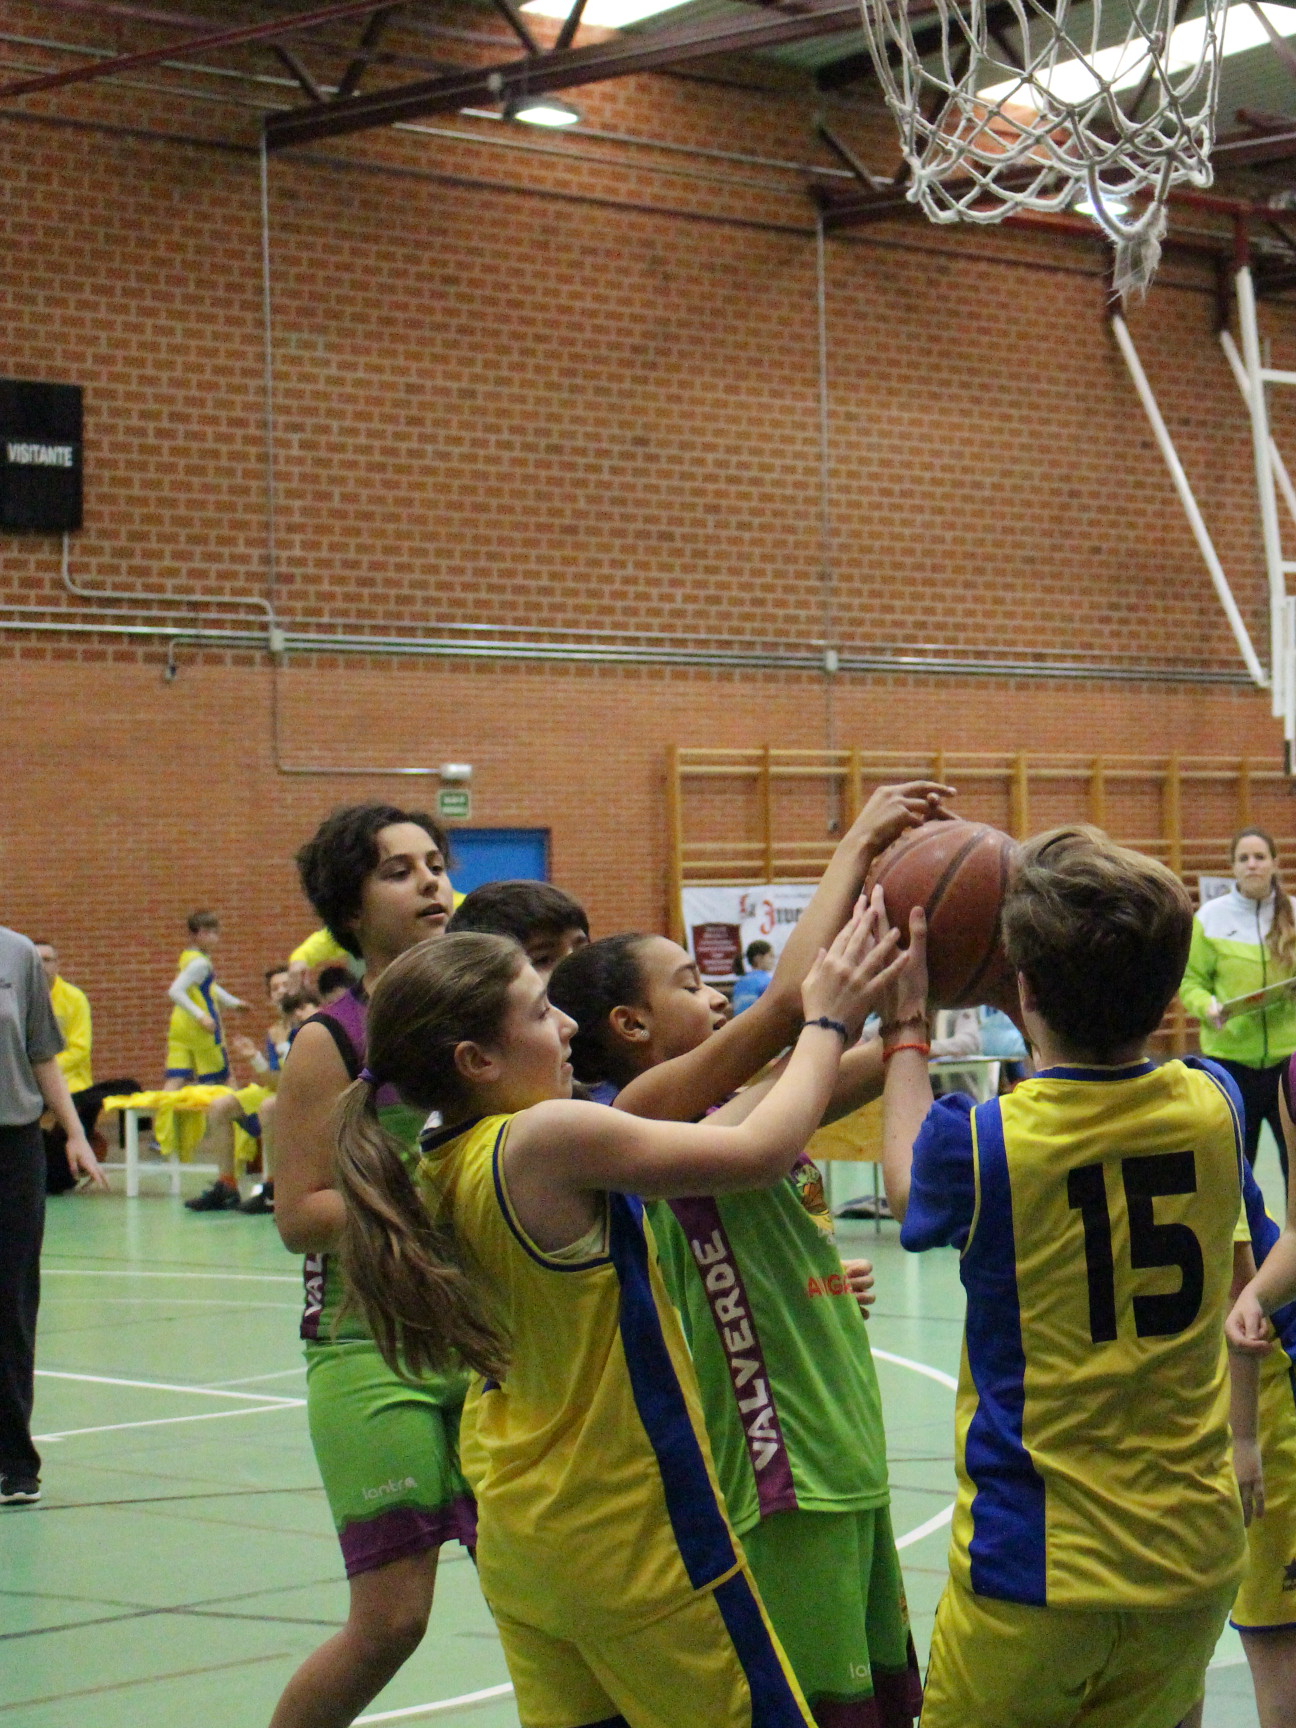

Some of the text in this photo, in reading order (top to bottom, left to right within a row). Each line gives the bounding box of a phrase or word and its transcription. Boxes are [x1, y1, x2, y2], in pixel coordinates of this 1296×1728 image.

[7, 442, 73, 467] VISITANTE
[1067, 1150, 1205, 1344] 15
[691, 1228, 778, 1471] VALVERDE
